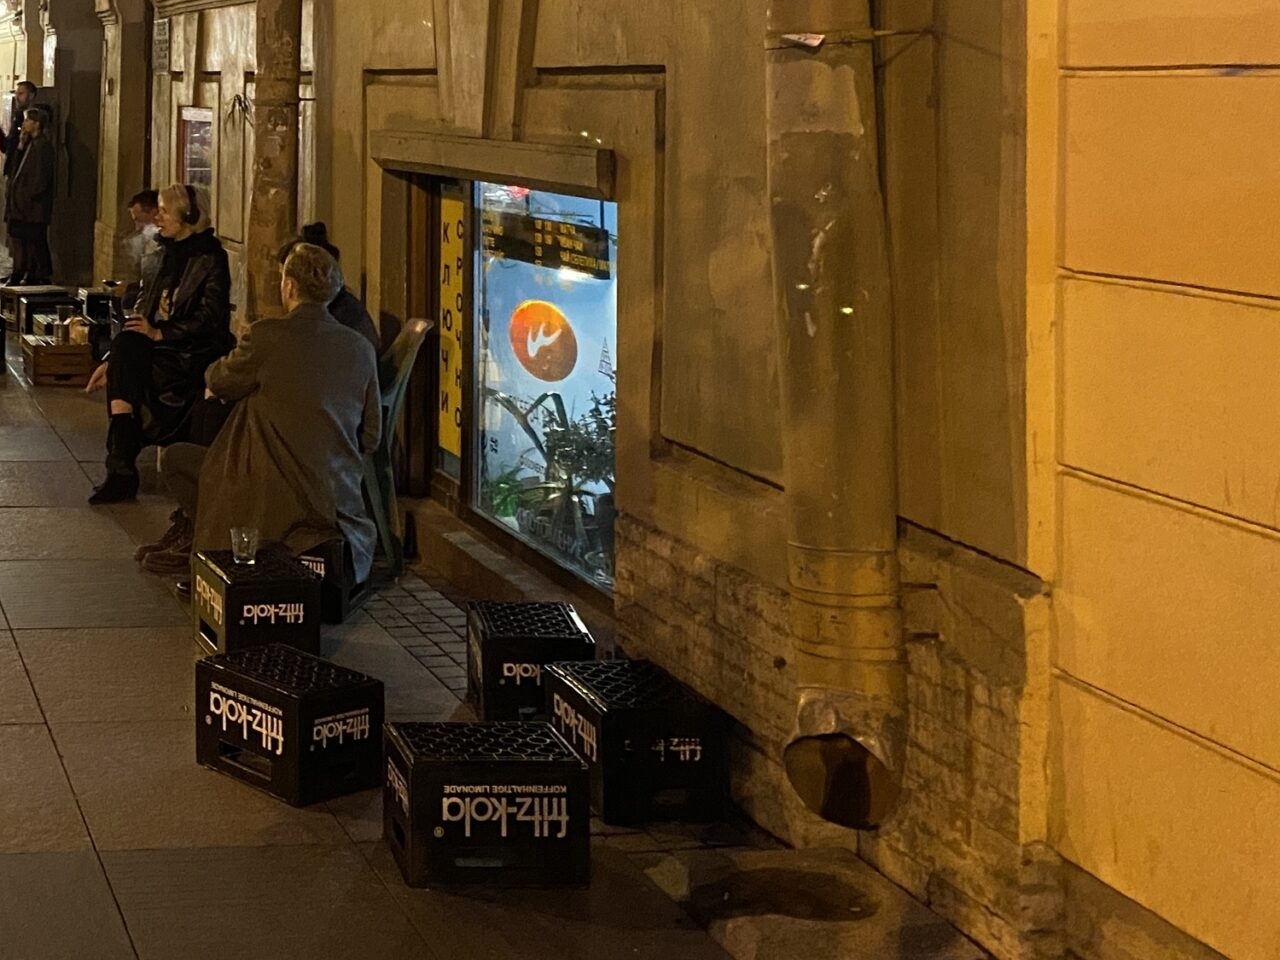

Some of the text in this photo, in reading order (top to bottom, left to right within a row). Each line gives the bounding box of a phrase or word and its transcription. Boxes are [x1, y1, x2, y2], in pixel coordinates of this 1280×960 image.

[242, 601, 305, 625] fritz-kola
[209, 690, 285, 756] fritz-kola
[312, 713, 371, 750] fritz-kola
[443, 784, 568, 794] KOFFEINHALTIGE LIMONADE
[441, 796, 570, 838] fritz-kola
